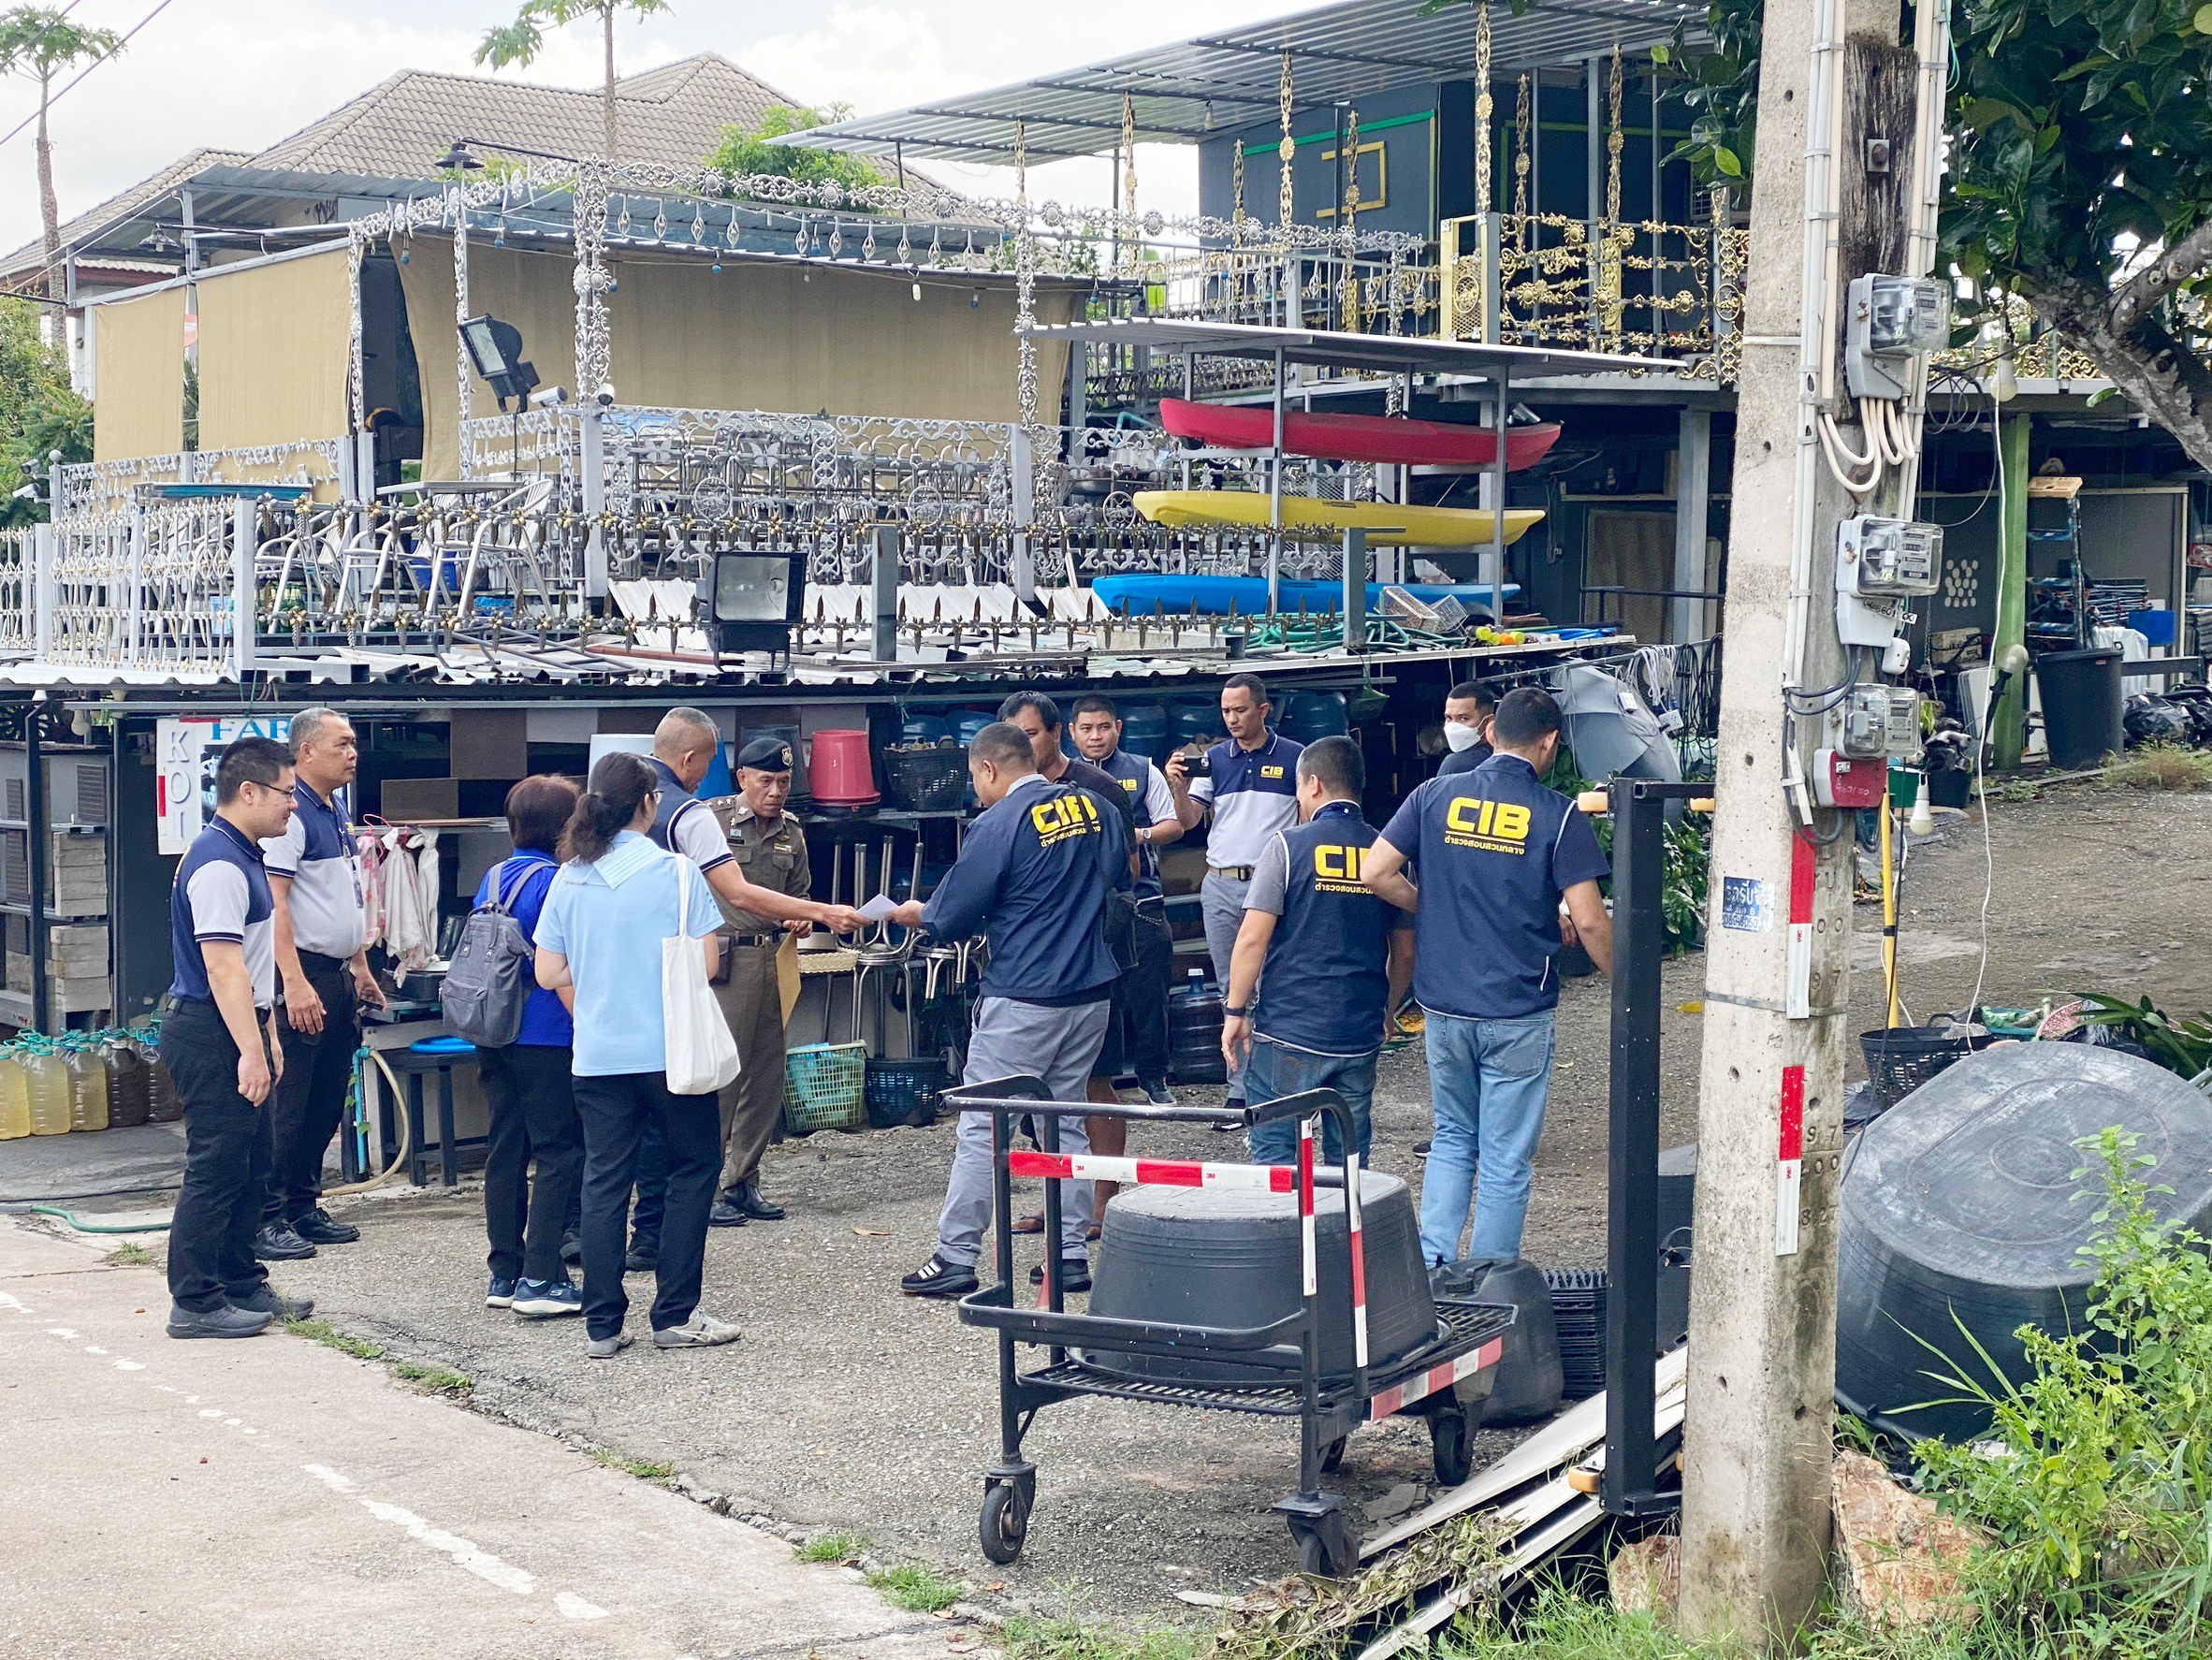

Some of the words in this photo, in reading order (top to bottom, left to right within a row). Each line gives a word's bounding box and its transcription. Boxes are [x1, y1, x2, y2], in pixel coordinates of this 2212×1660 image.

[1260, 765, 1284, 776] CIB
[167, 731, 191, 840] KOI
[1116, 779, 1137, 789] IB
[1447, 796, 1532, 840] CIB
[1315, 882, 1375, 895] ตำรวจสอบสวน
